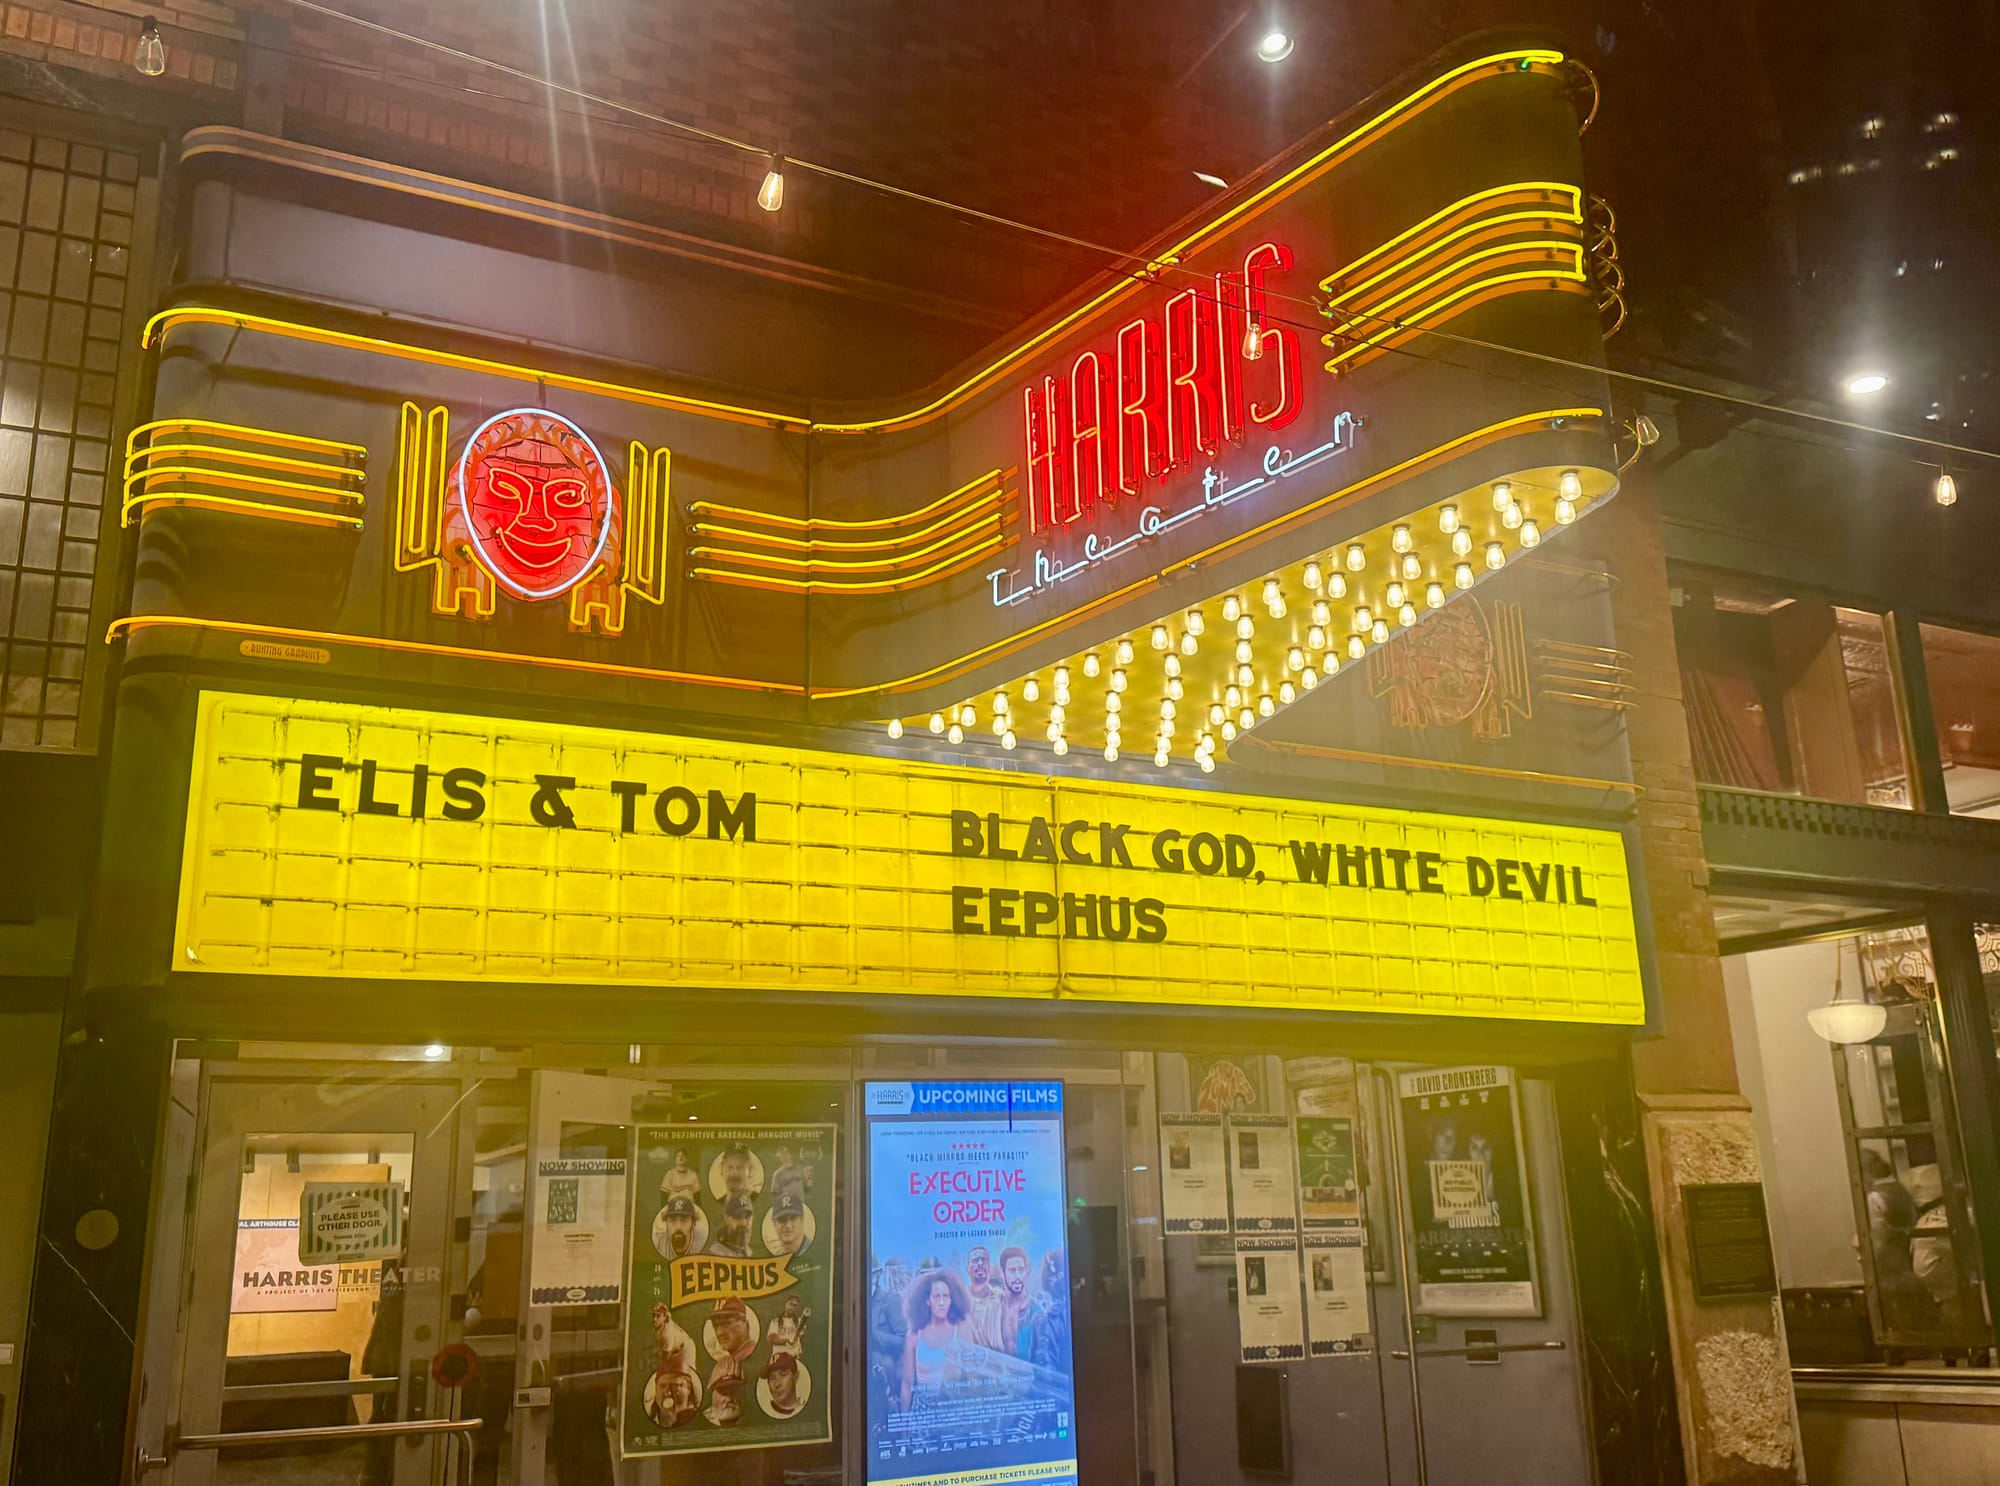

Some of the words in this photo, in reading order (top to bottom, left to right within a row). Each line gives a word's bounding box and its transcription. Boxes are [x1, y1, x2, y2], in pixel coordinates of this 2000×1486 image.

[1024, 242, 1302, 537] HARRIS
[298, 753, 487, 821] ELIS
[530, 774, 577, 829] &
[611, 781, 757, 842] TOM
[951, 810, 1131, 868] BLACK
[1152, 830, 1265, 885] GOD,
[1289, 840, 1445, 894] WHITE
[1466, 856, 1597, 908] DEVIL
[951, 886, 1168, 943] EEPHUS
[1416, 1075, 1441, 1094] DAVID
[1441, 1067, 1497, 1090] CRONENBERG
[919, 1089, 1007, 1104] UPCOMING
[1012, 1088, 1058, 1103] FILMS
[539, 1160, 567, 1170] NOW
[571, 1160, 625, 1171] SHOWING
[909, 1169, 1026, 1195] EXECUTIVE
[321, 1211, 358, 1222] PLEASE
[360, 1209, 380, 1219] USE
[933, 1199, 1006, 1224] ORDER
[318, 1221, 350, 1231] OTHER
[352, 1219, 383, 1229] DOOR.
[1258, 1238, 1296, 1247] SHOWING
[243, 1270, 333, 1288] HARRIS
[338, 1266, 441, 1285] THEATER
[680, 1262, 779, 1297] EEPHUS
[934, 1478, 949, 1486] AND
[961, 1473, 998, 1484] PURCHASE
[1000, 1470, 1026, 1479] TICKETS
[1027, 1467, 1053, 1477] PLEASE
[1054, 1465, 1071, 1473] VISIT
